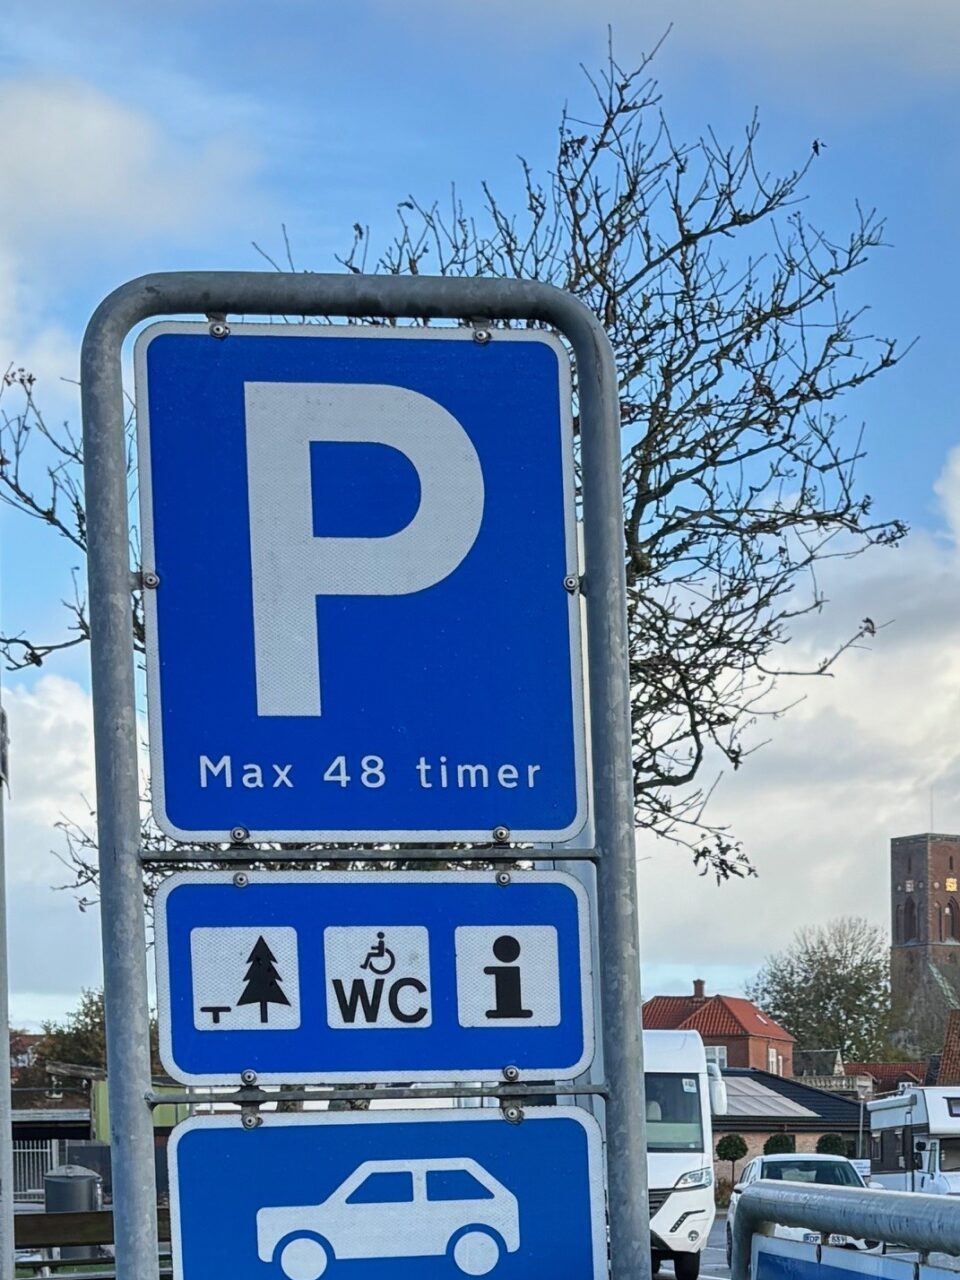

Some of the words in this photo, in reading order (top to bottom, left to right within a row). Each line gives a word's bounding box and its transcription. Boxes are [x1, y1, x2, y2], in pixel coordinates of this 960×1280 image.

[244, 381, 485, 717] P
[199, 755, 294, 788] Max
[323, 755, 386, 788] 48
[416, 755, 541, 788] timer
[332, 977, 428, 1023] WC
